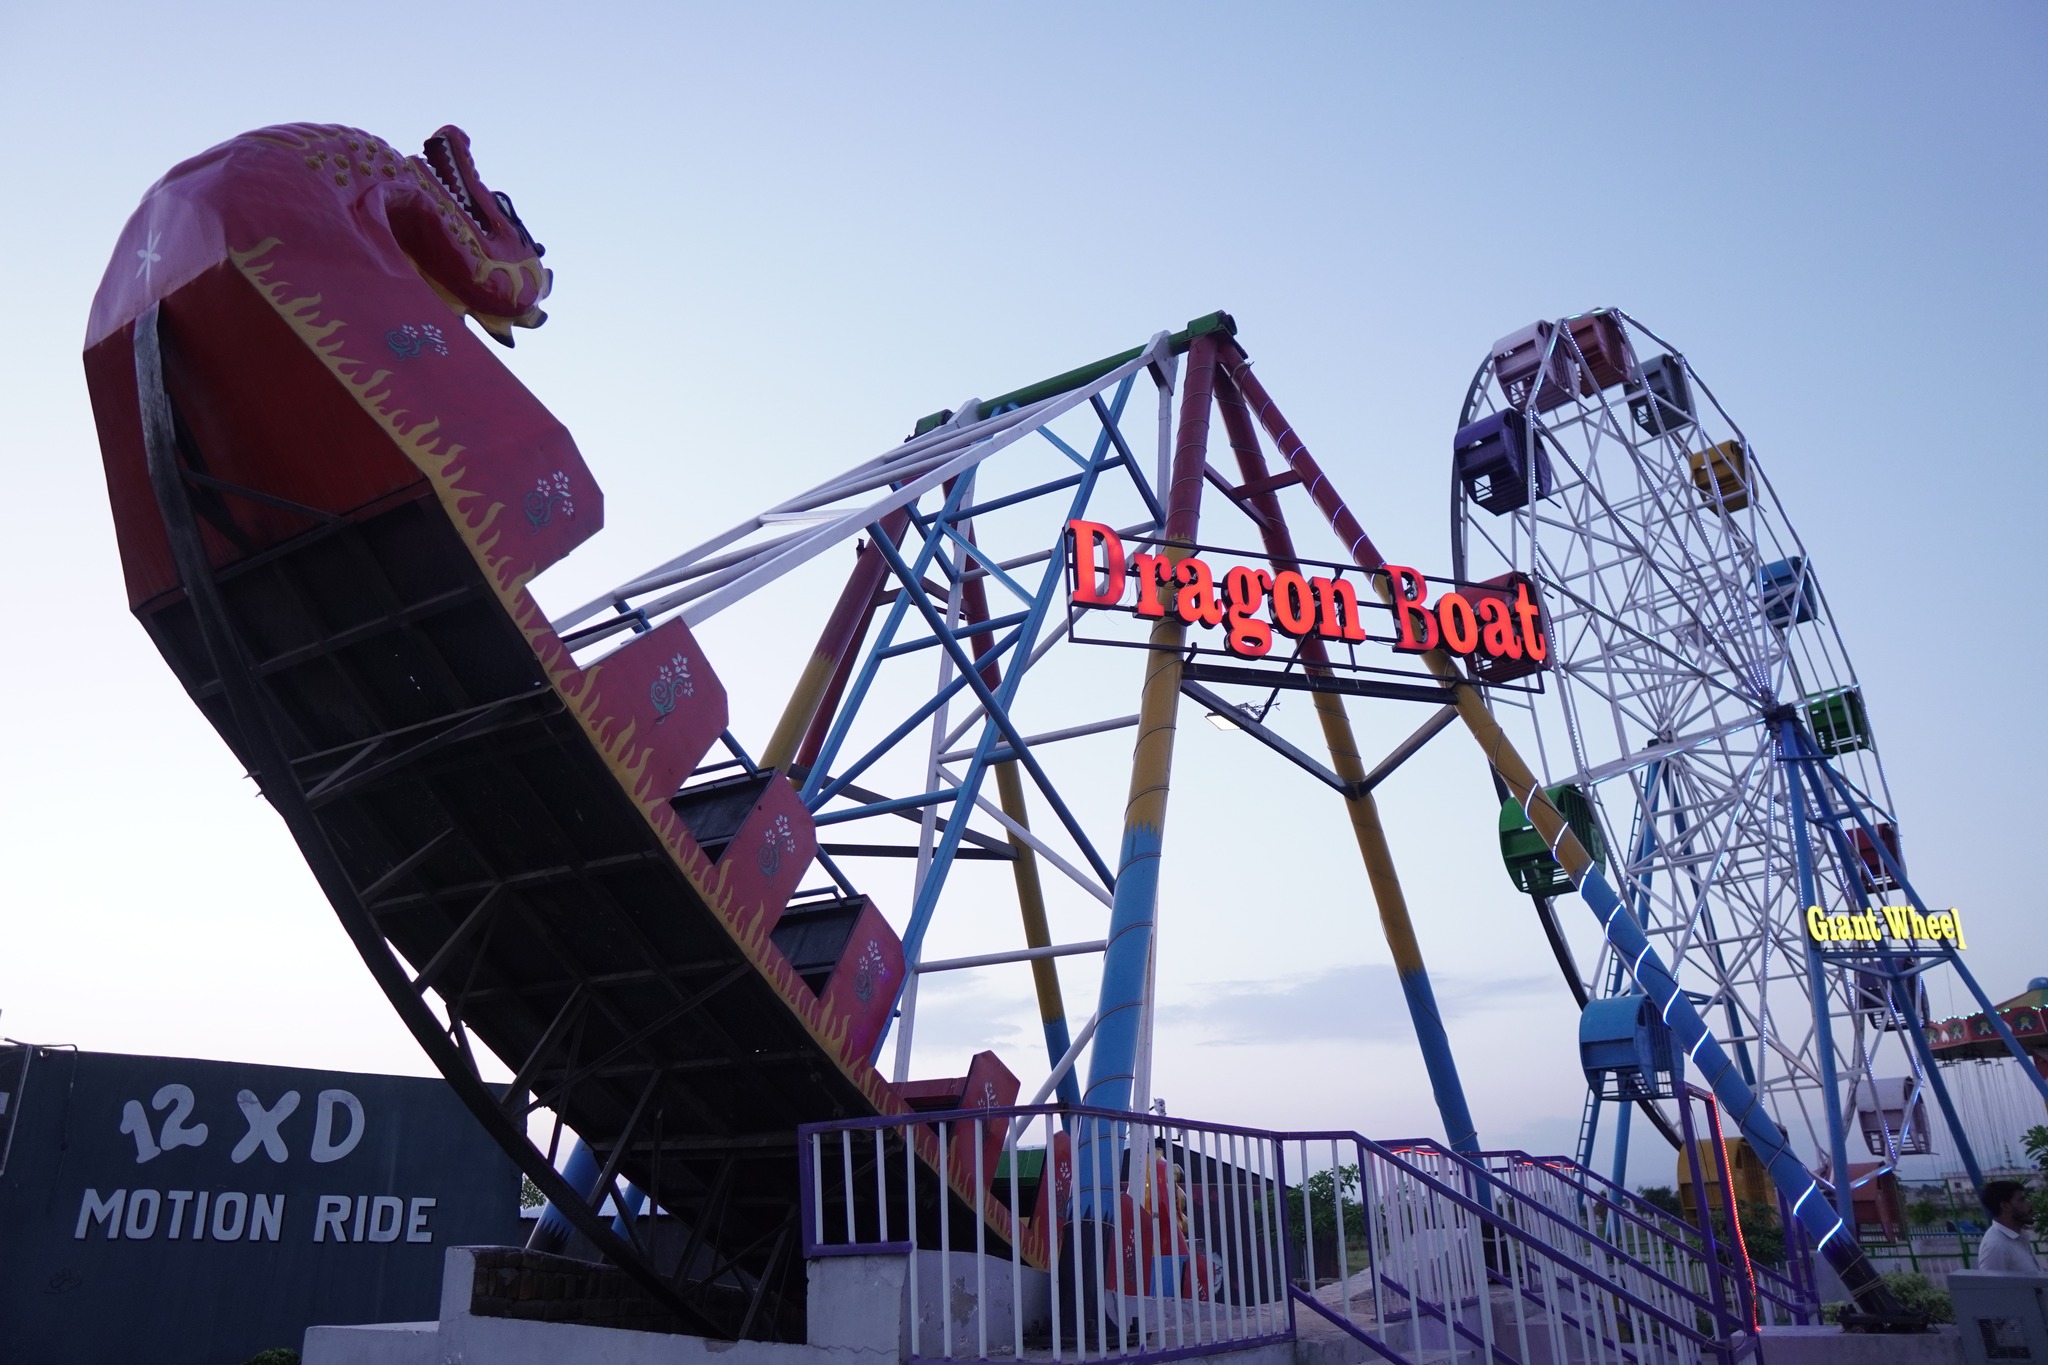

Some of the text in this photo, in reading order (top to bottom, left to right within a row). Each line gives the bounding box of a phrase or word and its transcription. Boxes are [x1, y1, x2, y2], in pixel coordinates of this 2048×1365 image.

[1069, 519, 1547, 662] Dragon Boat
[1807, 905, 1967, 950] Giant Wheel
[120, 1083, 208, 1163] 12
[74, 1188, 437, 1243] MOTION RIDE
